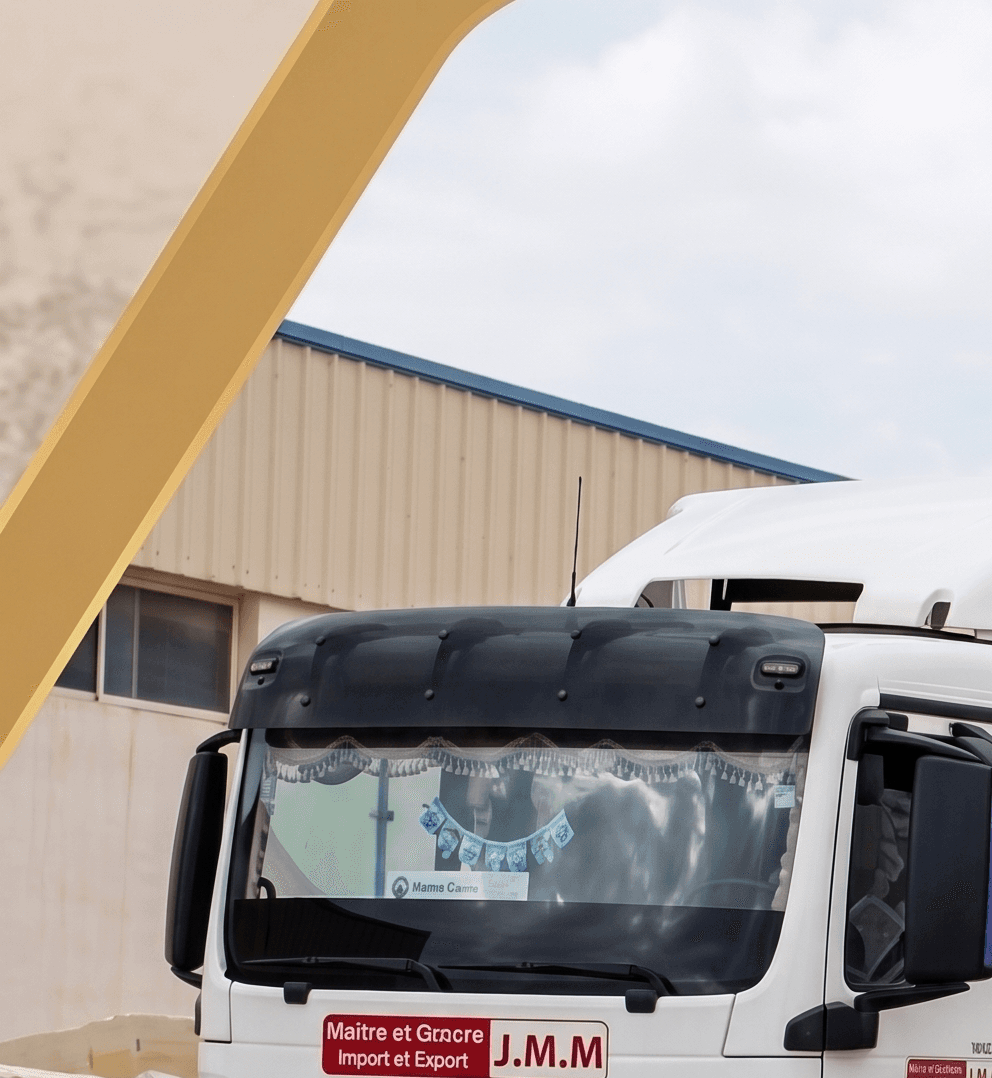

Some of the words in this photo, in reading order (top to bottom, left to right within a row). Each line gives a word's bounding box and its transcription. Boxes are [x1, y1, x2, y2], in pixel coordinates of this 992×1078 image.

[392, 1024, 412, 1042] et
[338, 1049, 390, 1070] Import
[393, 1050, 410, 1067] et
[414, 1050, 469, 1072] Export
